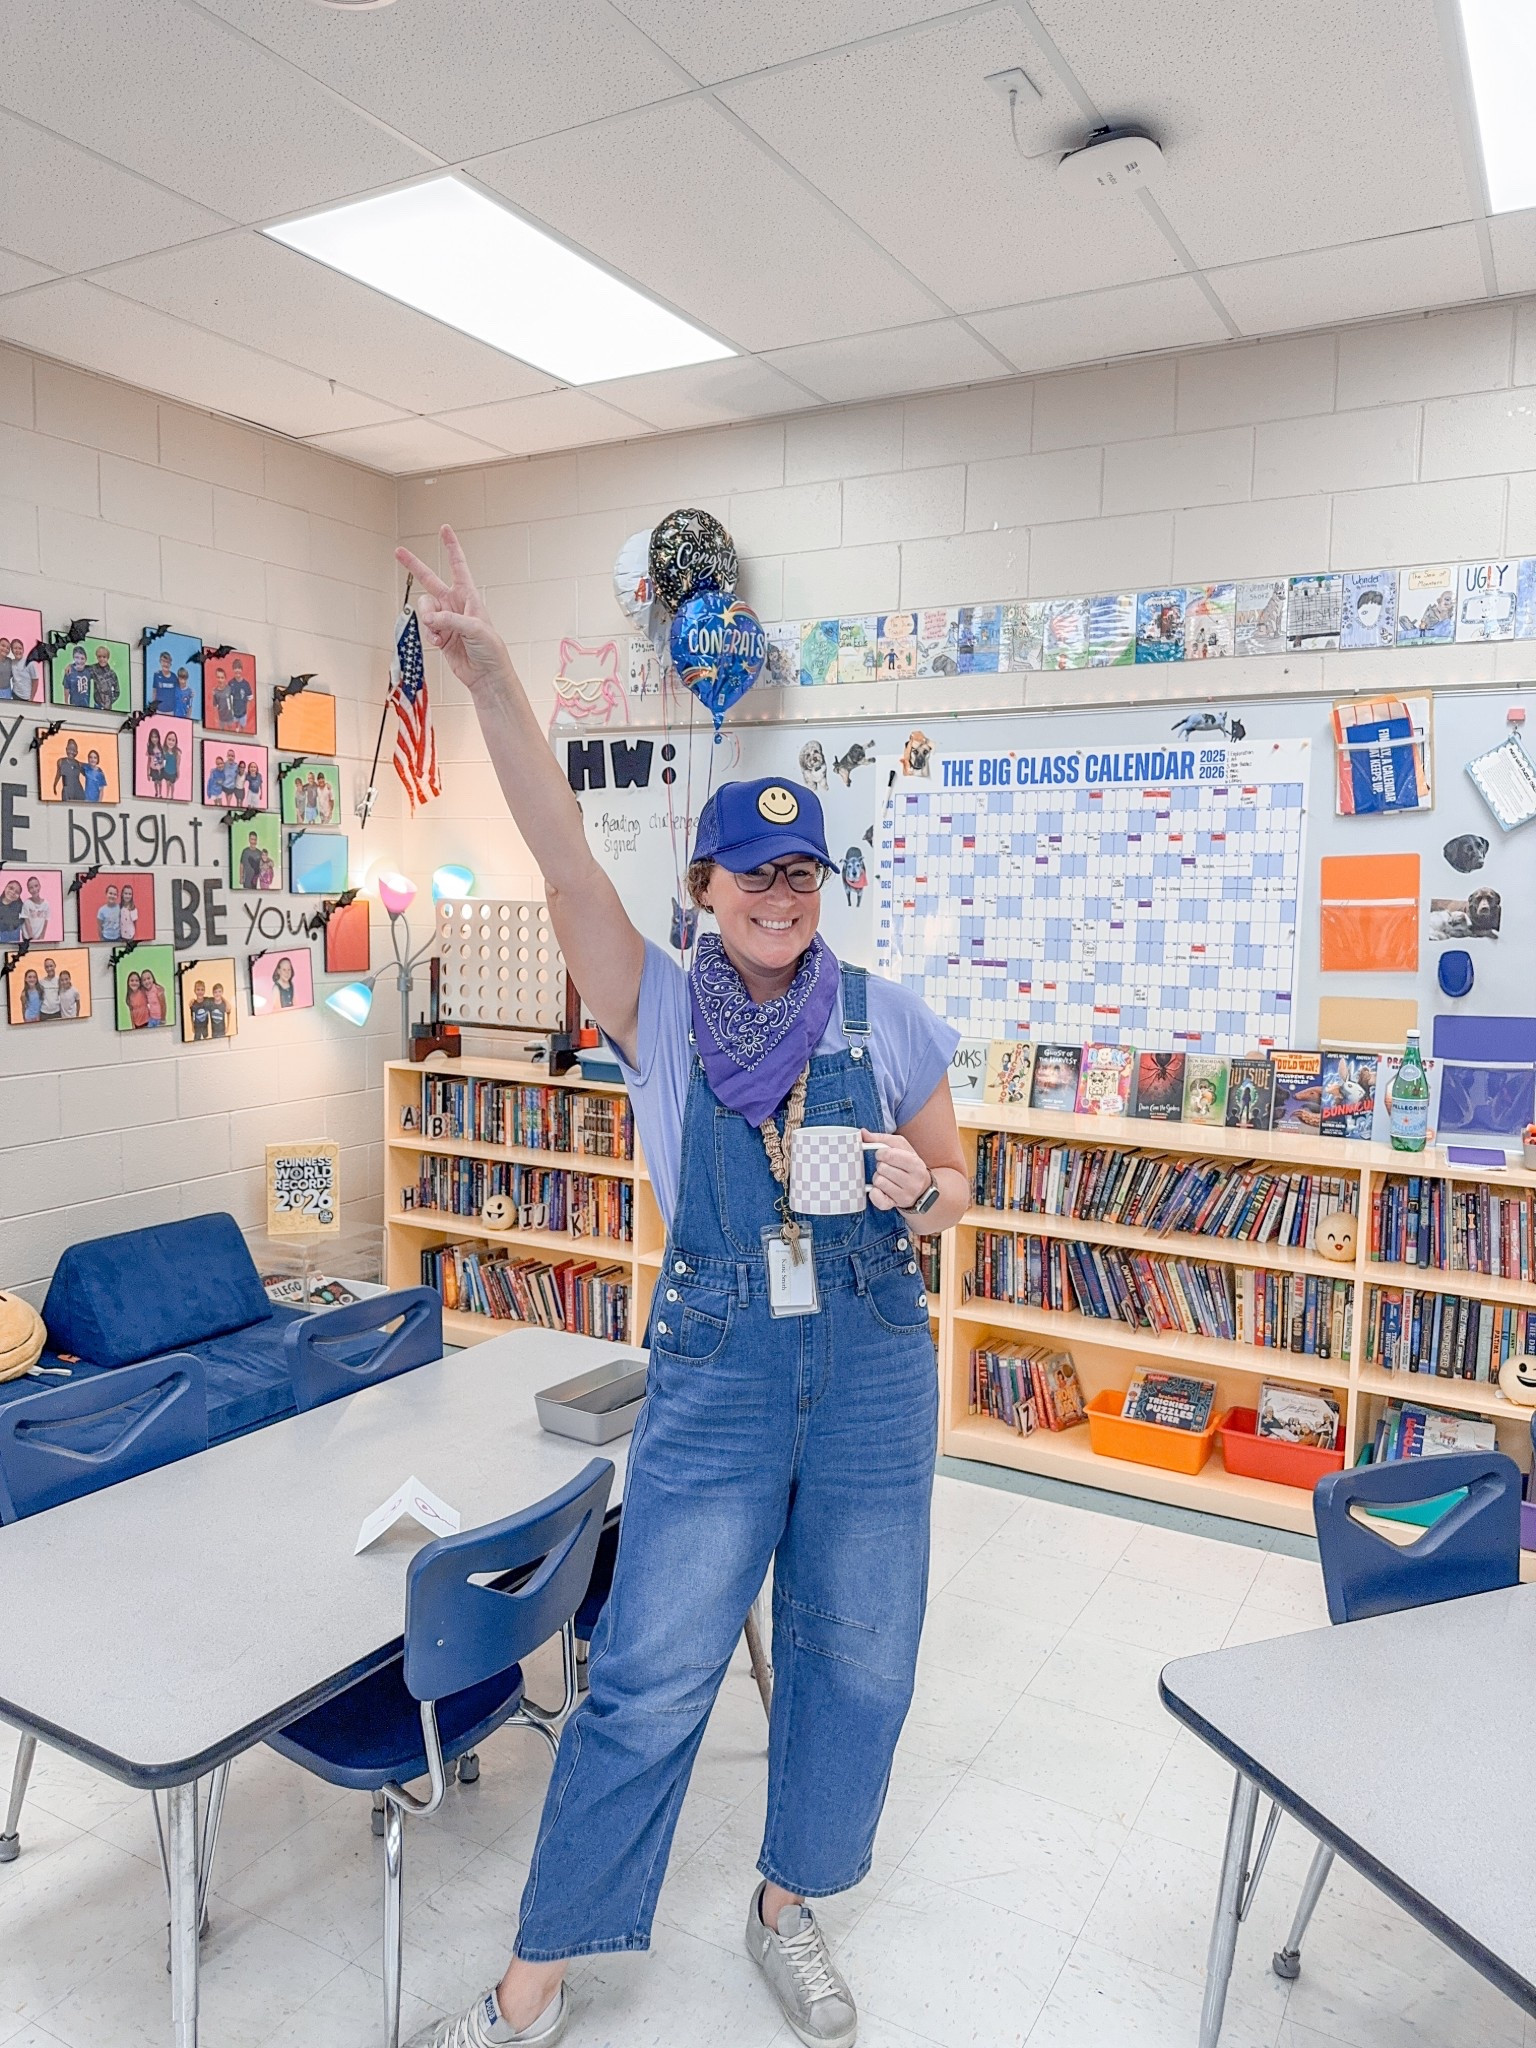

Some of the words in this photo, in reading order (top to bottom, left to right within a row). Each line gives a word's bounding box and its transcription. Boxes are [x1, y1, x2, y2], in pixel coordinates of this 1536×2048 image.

[676, 542, 739, 579] Congrats
[1466, 565, 1509, 591] UGLY
[688, 628, 764, 658] CONGRATS
[567, 740, 677, 791] HW:
[1200, 750, 1225, 762] 2025
[942, 760, 974, 787] THE
[979, 757, 1011, 785] BIG
[1016, 754, 1080, 785] CLASS
[1085, 750, 1194, 782] CALENDAR
[1199, 765, 1225, 779] 2026
[1370, 759, 1382, 783] KEEPS
[1372, 783, 1384, 795] UP.
[1381, 764, 1397, 803] CALENDAR
[602, 812, 641, 837] Reading
[882, 820, 893, 829] SEP
[604, 836, 637, 861] signed
[881, 841, 892, 849] OCT
[880, 860, 892, 869] NOV
[881, 880, 891, 889] DEC
[172, 878, 228, 950] BE
[880, 900, 891, 909] JAN
[881, 919, 891, 928] FEB
[876, 939, 890, 948] MAR
[952, 1048, 988, 1069] OOKS!
[1044, 1048, 1065, 1057] GHOST
[1050, 1056, 1078, 1066] HARVEST
[1298, 1058, 1320, 1073] WIN?
[1229, 1066, 1271, 1089] OUTSIDE
[402, 1105, 415, 1127] A
[432, 1117, 444, 1138] B
[274, 1157, 332, 1168] GUINNESS
[275, 1167, 333, 1179] WORLD
[274, 1178, 334, 1190] RECORDS
[274, 1189, 334, 1215] 2026
[403, 1191, 415, 1212] H
[536, 1205, 546, 1228] J
[571, 1214, 583, 1237] K
[1120, 1264, 1137, 1292] ONYEKA
[1294, 1275, 1304, 1298] PONY
[276, 1281, 302, 1297] LEGO
[1292, 1301, 1303, 1337] PALACIO
[1145, 1403, 1194, 1420] PUZZLES
[1148, 1396, 1196, 1412] TRICKIEST
[1155, 1412, 1180, 1424] EVER
